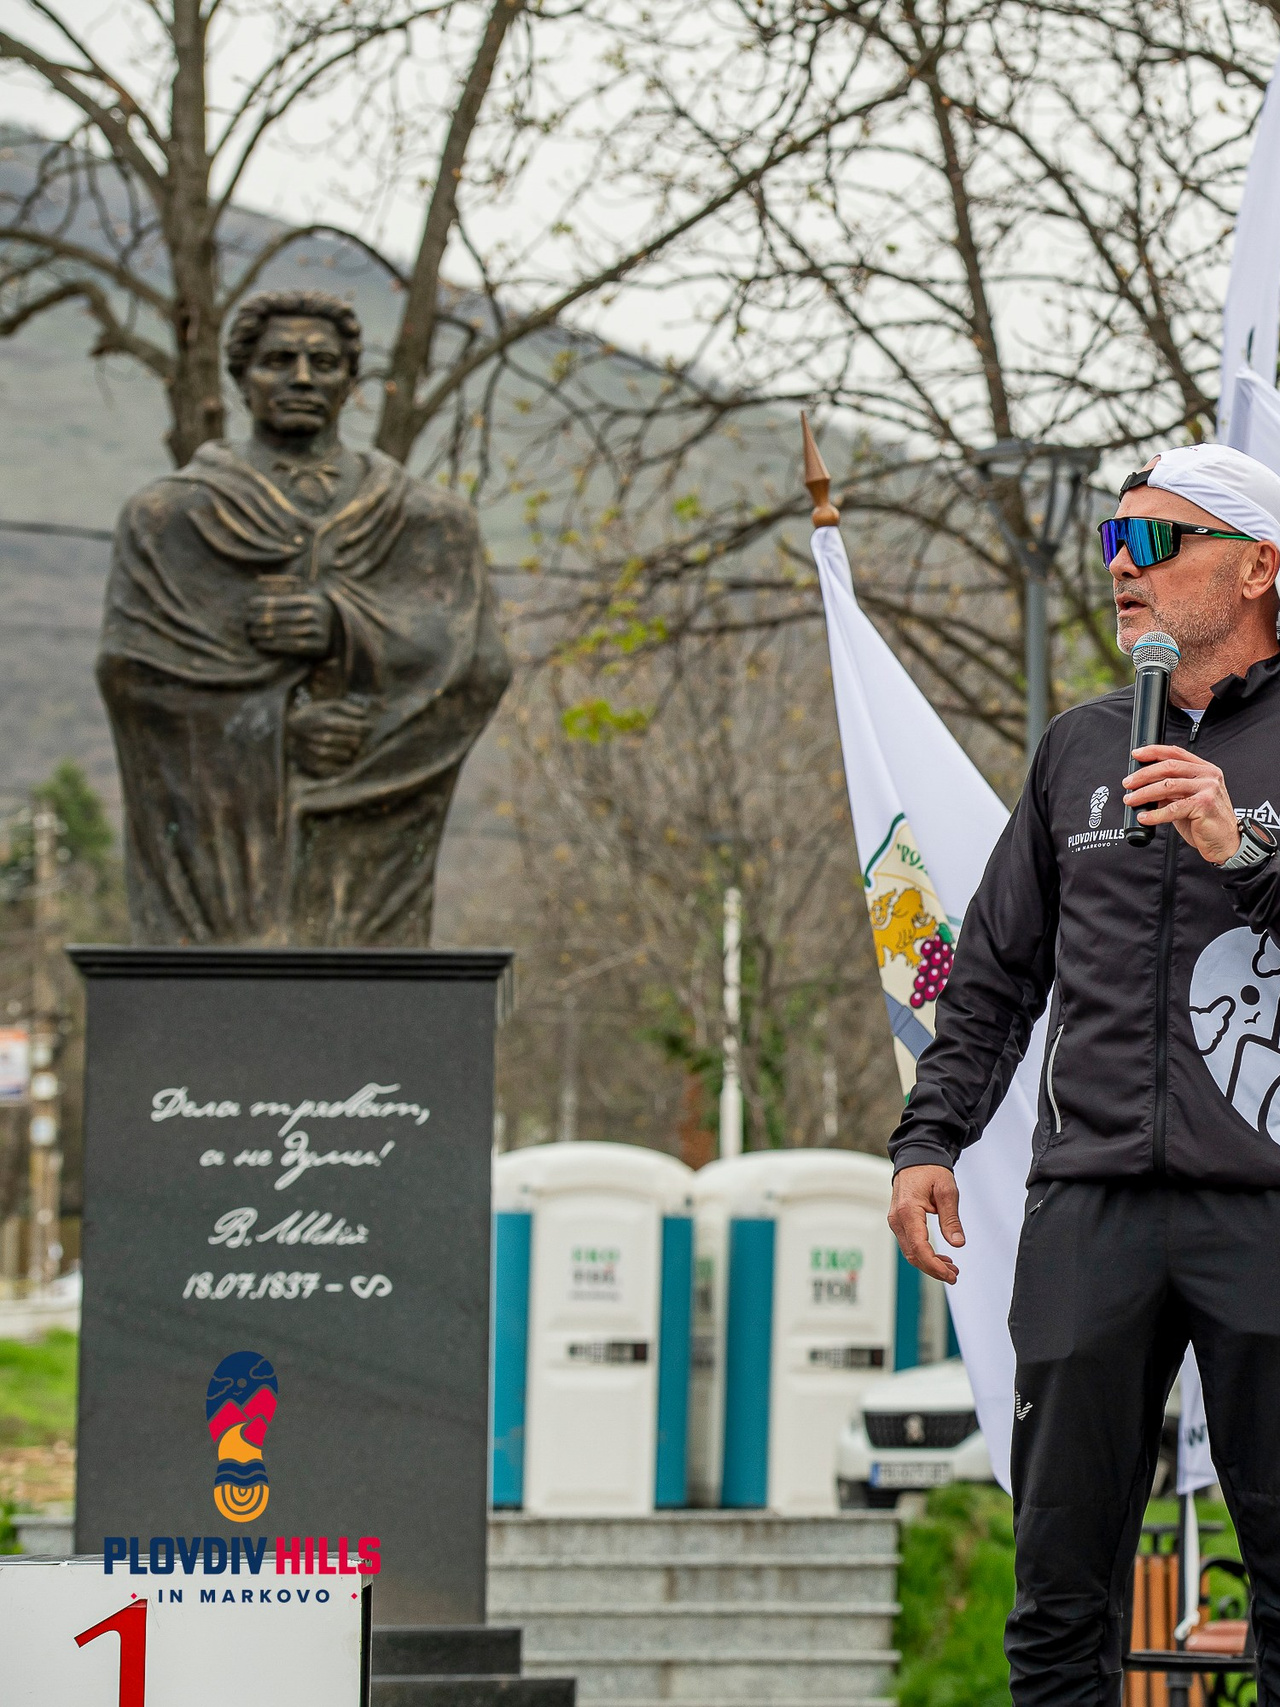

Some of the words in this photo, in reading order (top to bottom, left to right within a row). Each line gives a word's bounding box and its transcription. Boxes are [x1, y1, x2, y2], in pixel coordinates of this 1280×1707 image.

[1068, 831, 1099, 848] PLOVDIV
[1099, 829, 1125, 840] HILLS
[150, 1085, 241, 1122] Дела
[199, 1149, 226, 1167] а
[233, 1149, 273, 1167] не
[74, 1598, 148, 1707] 1
